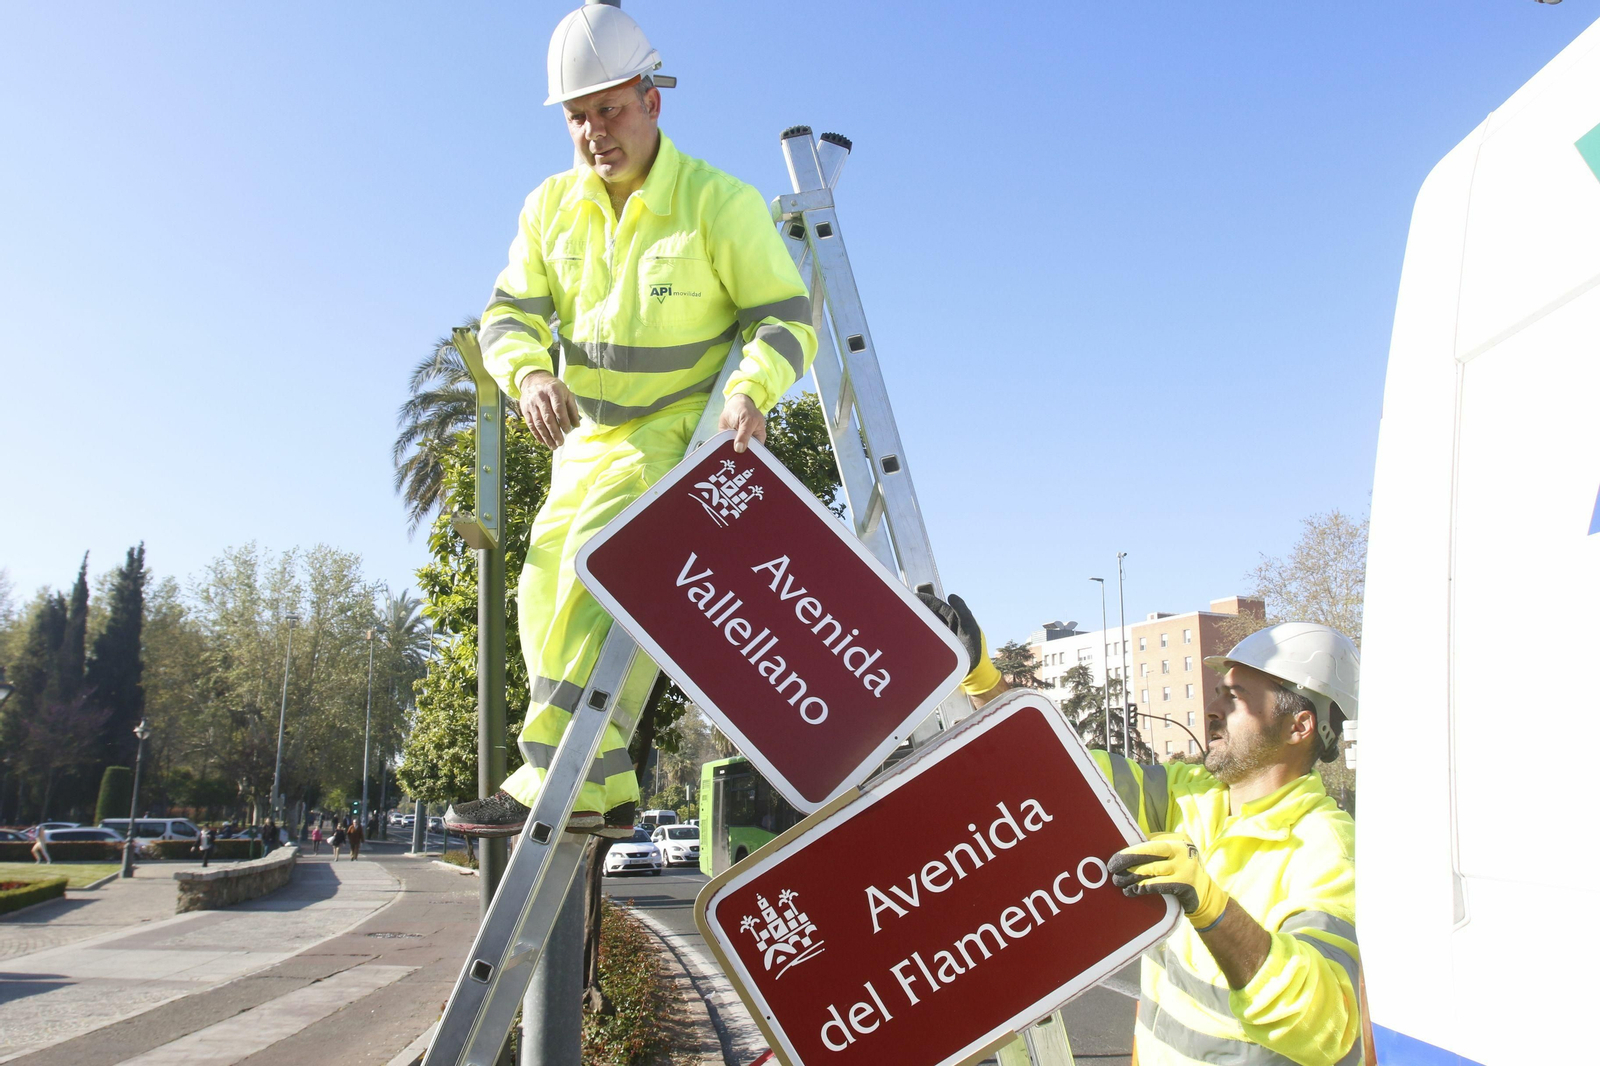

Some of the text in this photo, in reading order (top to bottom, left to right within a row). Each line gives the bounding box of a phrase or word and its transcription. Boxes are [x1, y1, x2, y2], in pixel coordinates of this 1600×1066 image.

[650, 287, 672, 296] API
[676, 552, 828, 725] Vallellano
[751, 555, 891, 698] Avenida
[865, 799, 1053, 934] Avenida
[821, 856, 1109, 1051] del Flamenco
